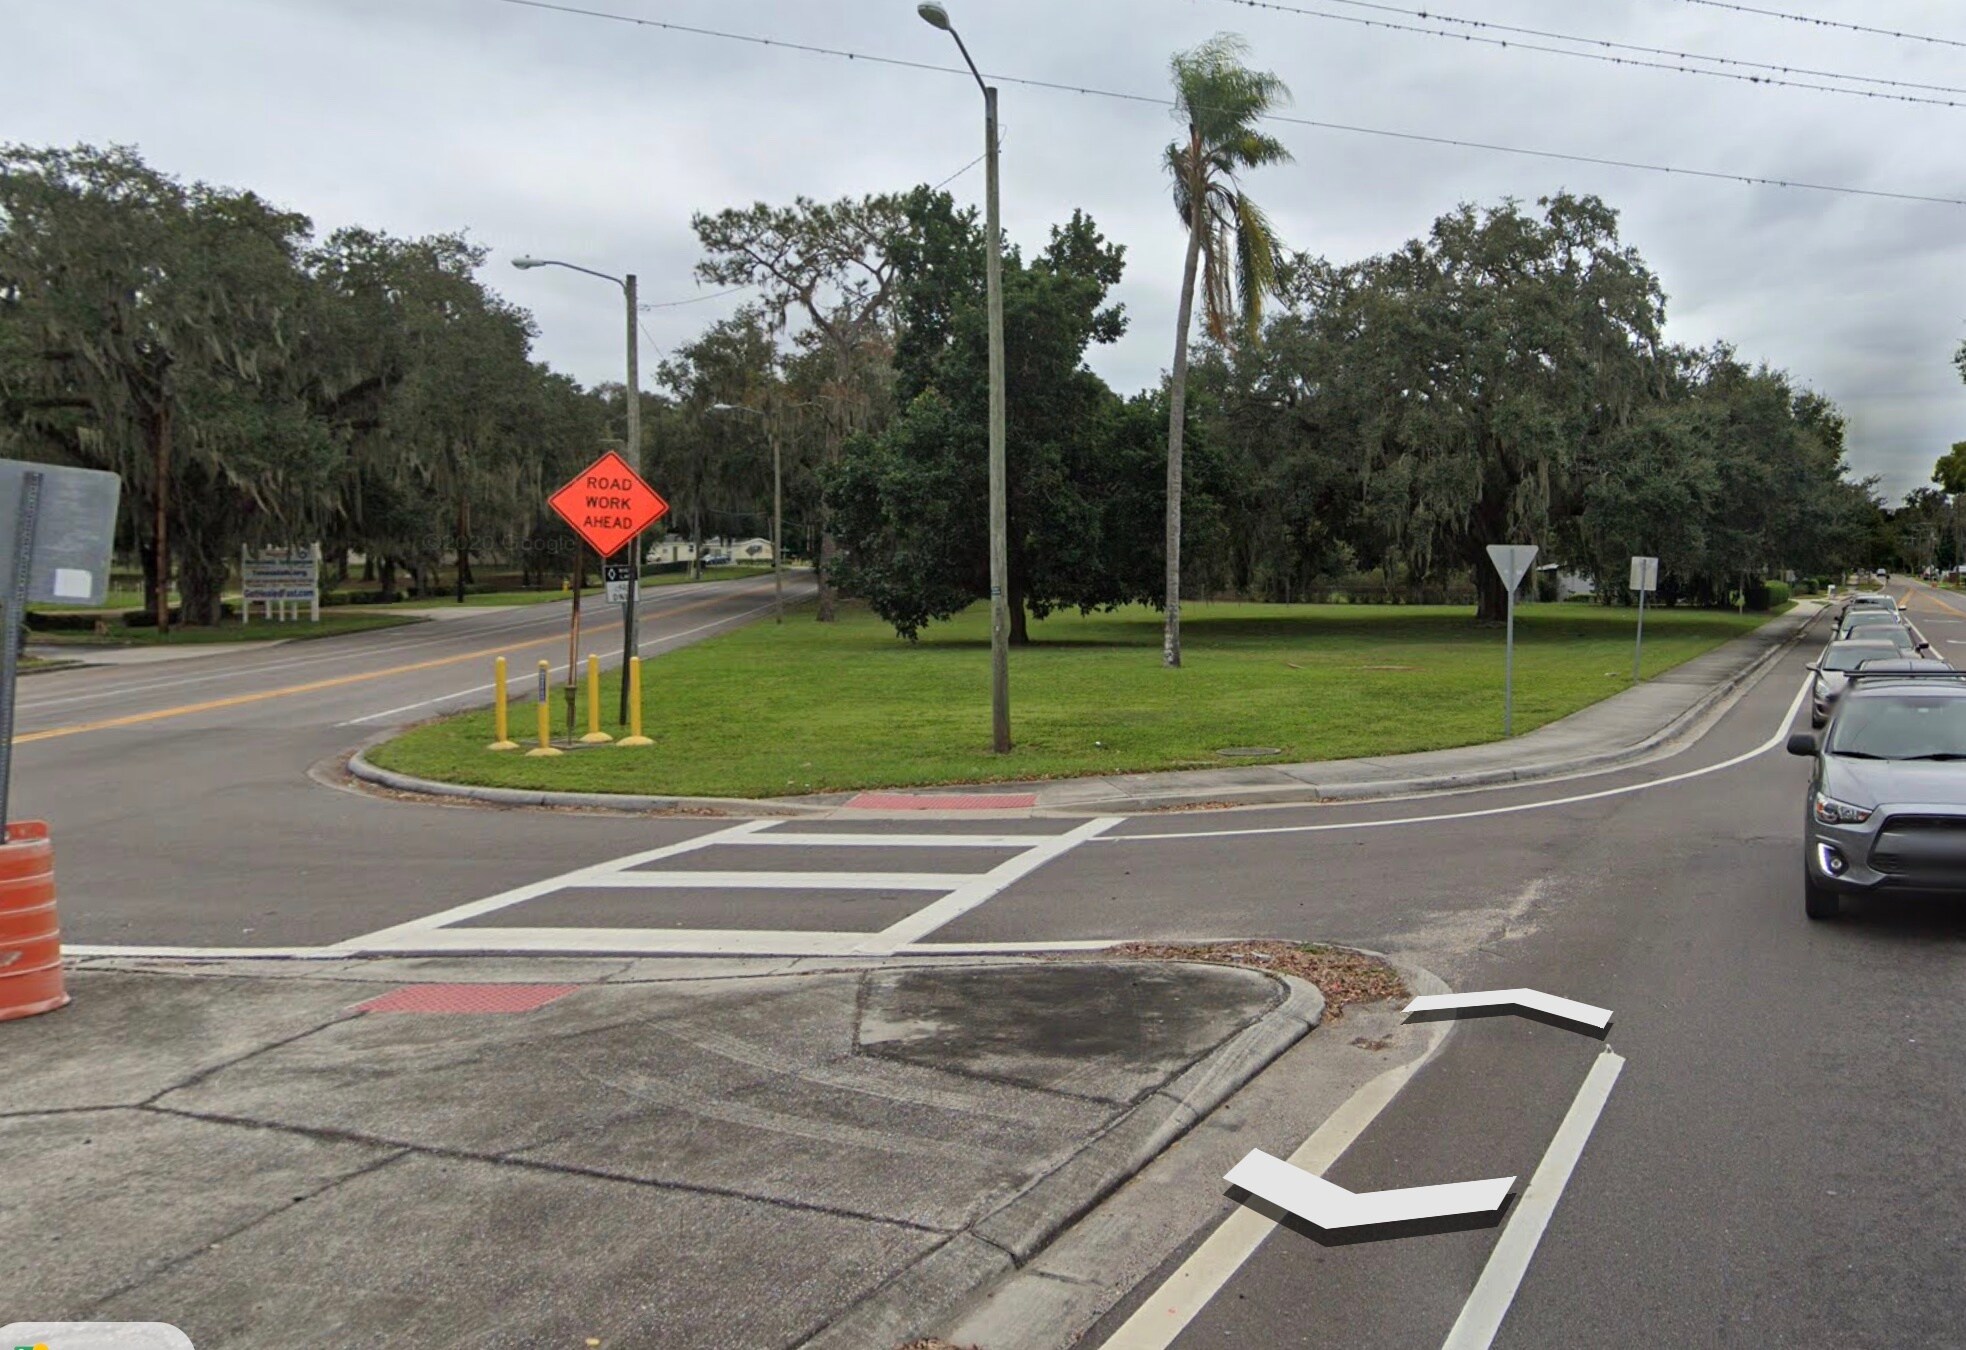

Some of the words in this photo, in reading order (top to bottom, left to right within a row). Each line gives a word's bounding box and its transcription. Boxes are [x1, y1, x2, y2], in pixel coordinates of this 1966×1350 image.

[587, 477, 632, 491] ROAD
[586, 496, 631, 510] WORK
[583, 516, 633, 530] AHEAD
